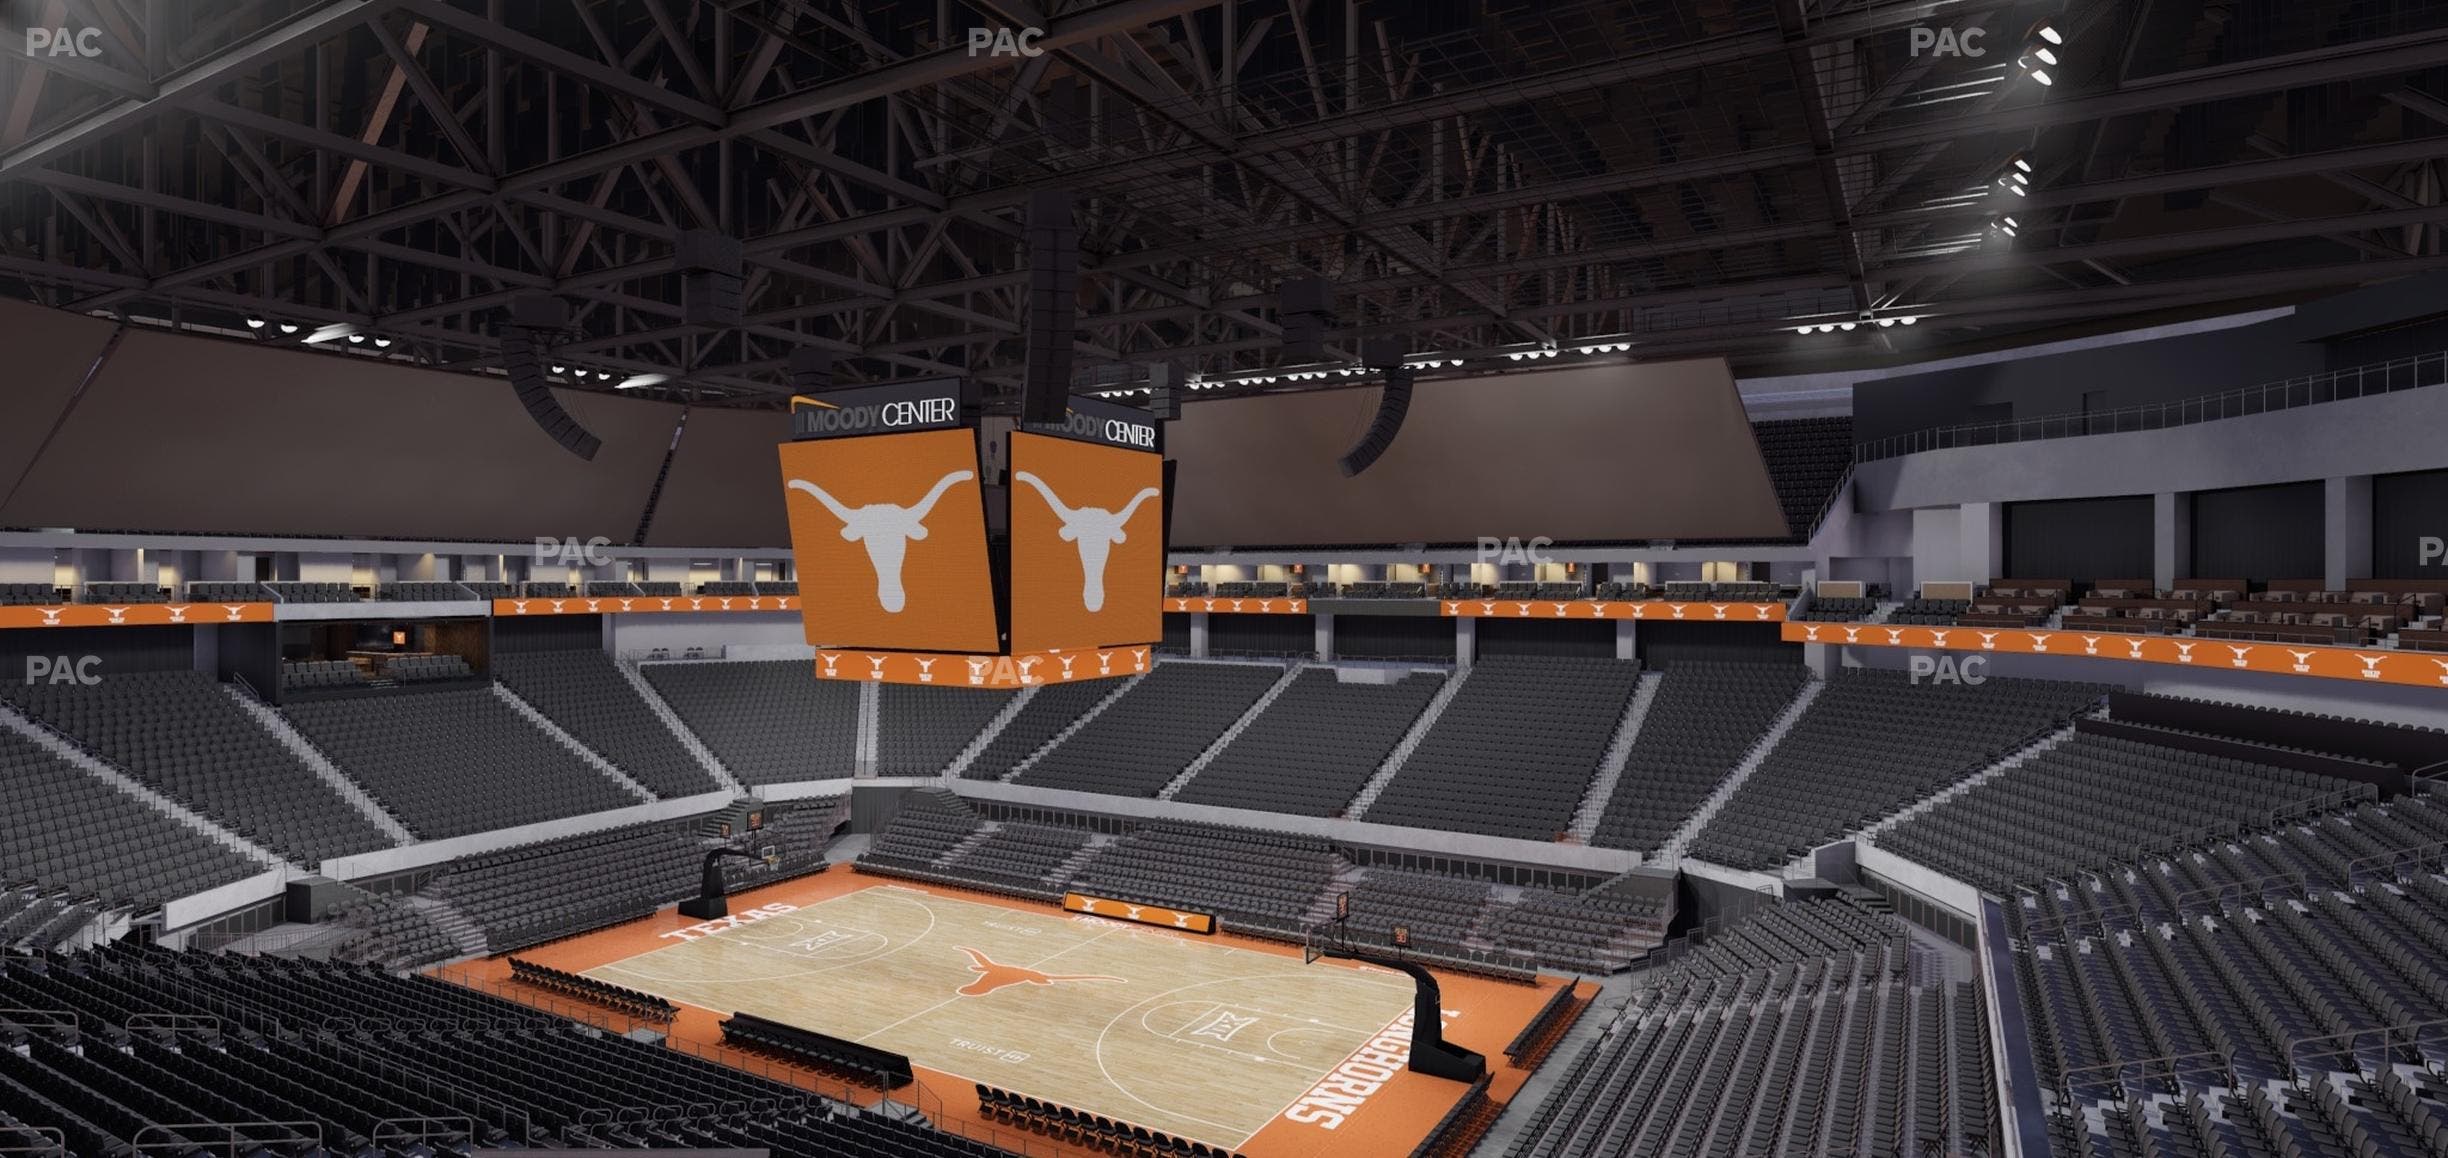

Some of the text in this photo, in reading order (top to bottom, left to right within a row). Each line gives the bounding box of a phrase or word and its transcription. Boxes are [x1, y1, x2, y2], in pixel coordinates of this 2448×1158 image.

[808, 398, 955, 432] MOODY CENTER
[1105, 419, 1156, 448] CENTER
[658, 902, 800, 942] TEXAS
[950, 1038, 1006, 1056] TRUIST
[1285, 1007, 1461, 1130] NGHORNS
